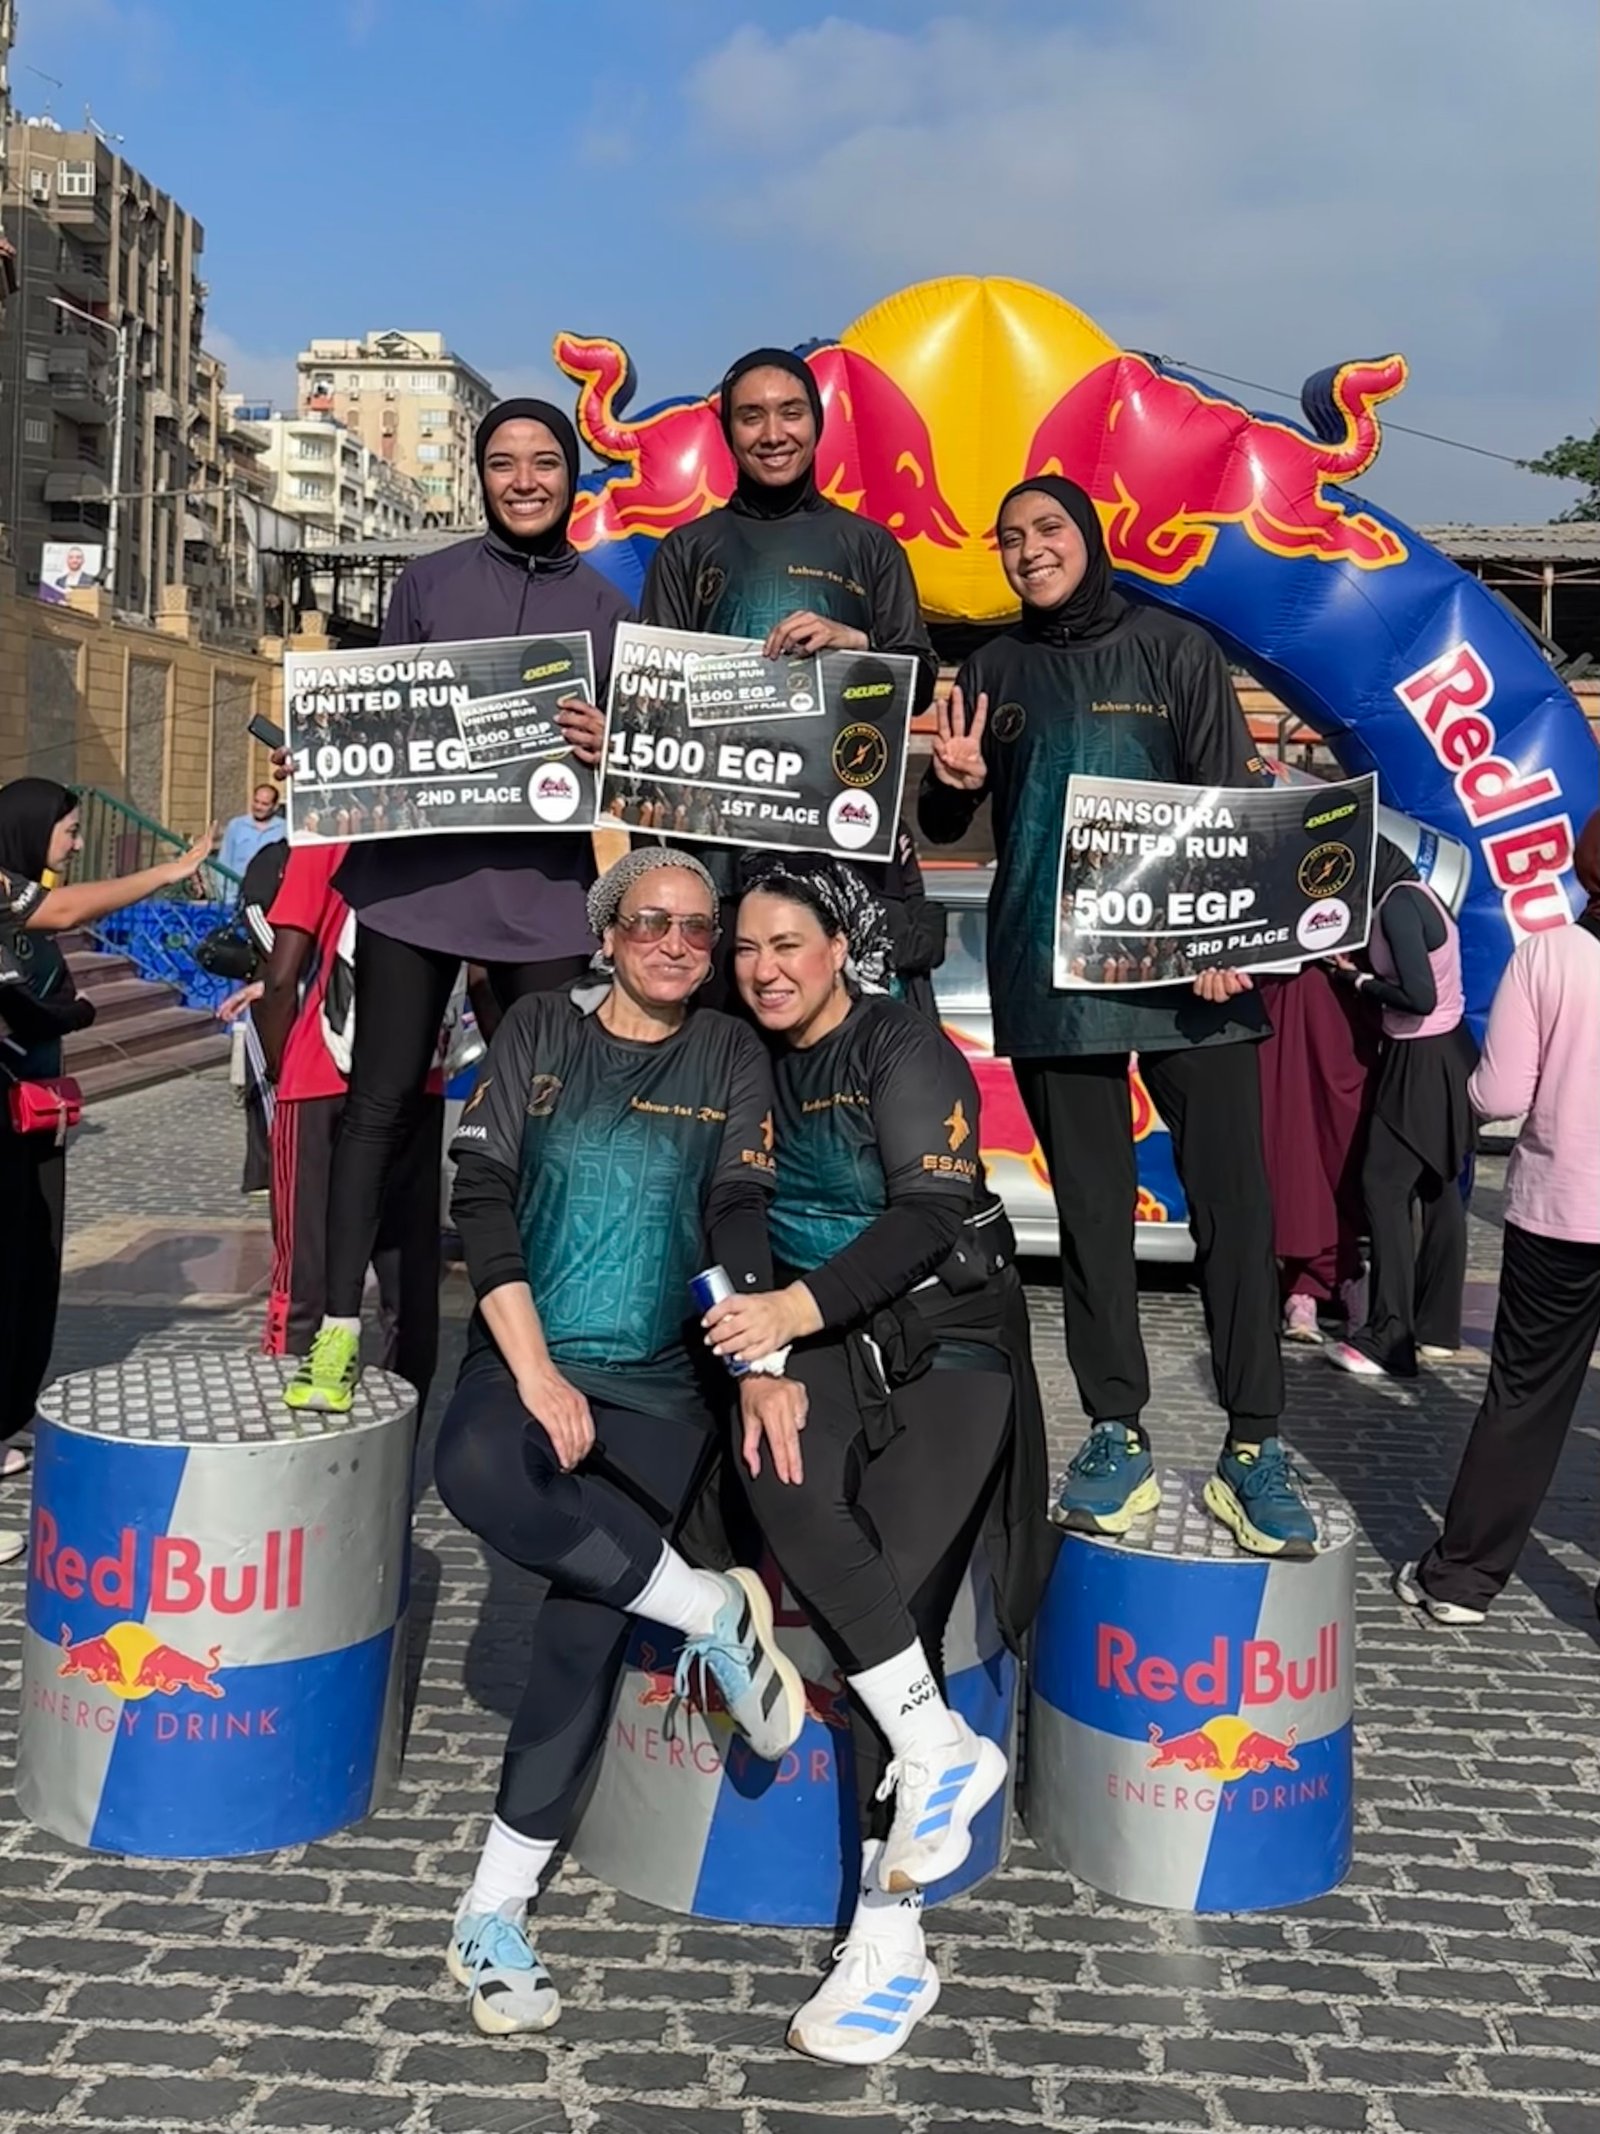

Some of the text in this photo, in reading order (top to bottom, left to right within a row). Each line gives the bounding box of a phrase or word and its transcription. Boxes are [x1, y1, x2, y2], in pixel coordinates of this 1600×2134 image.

[294, 659, 456, 689] MANSOURA
[619, 673, 687, 702] UNIT
[738, 668, 765, 679] RUN
[295, 685, 469, 715] UNITED RUN
[690, 686, 776, 703] 1500 EGP
[511, 707, 537, 718] RUN
[467, 722, 551, 747] 1000 EGP
[294, 740, 467, 781] 1000 EG
[609, 731, 803, 785] 1500 EGP
[416, 787, 456, 807] 2ND
[461, 786, 521, 804] PLACE
[1399, 645, 1572, 937] Red Bu
[720, 799, 752, 817] 1ST
[759, 803, 819, 825] PLACE
[1073, 795, 1234, 829] MANSOURA
[1071, 828, 1248, 859] UNITED RUN
[1073, 888, 1256, 927] 500 EGP
[1185, 928, 1289, 958] 3RD PLACE
[457, 1125, 488, 1140] SAVA
[741, 1149, 776, 1169] ESA
[34, 1507, 305, 1615] Red Bull
[1096, 1620, 1339, 1706] Red Bull
[909, 1673, 931, 1694] GO
[33, 1681, 280, 1741] ENERGY DRINK
[616, 1722, 748, 1778] NERGY
[1107, 1773, 1330, 1813] ENERGY DRINK
